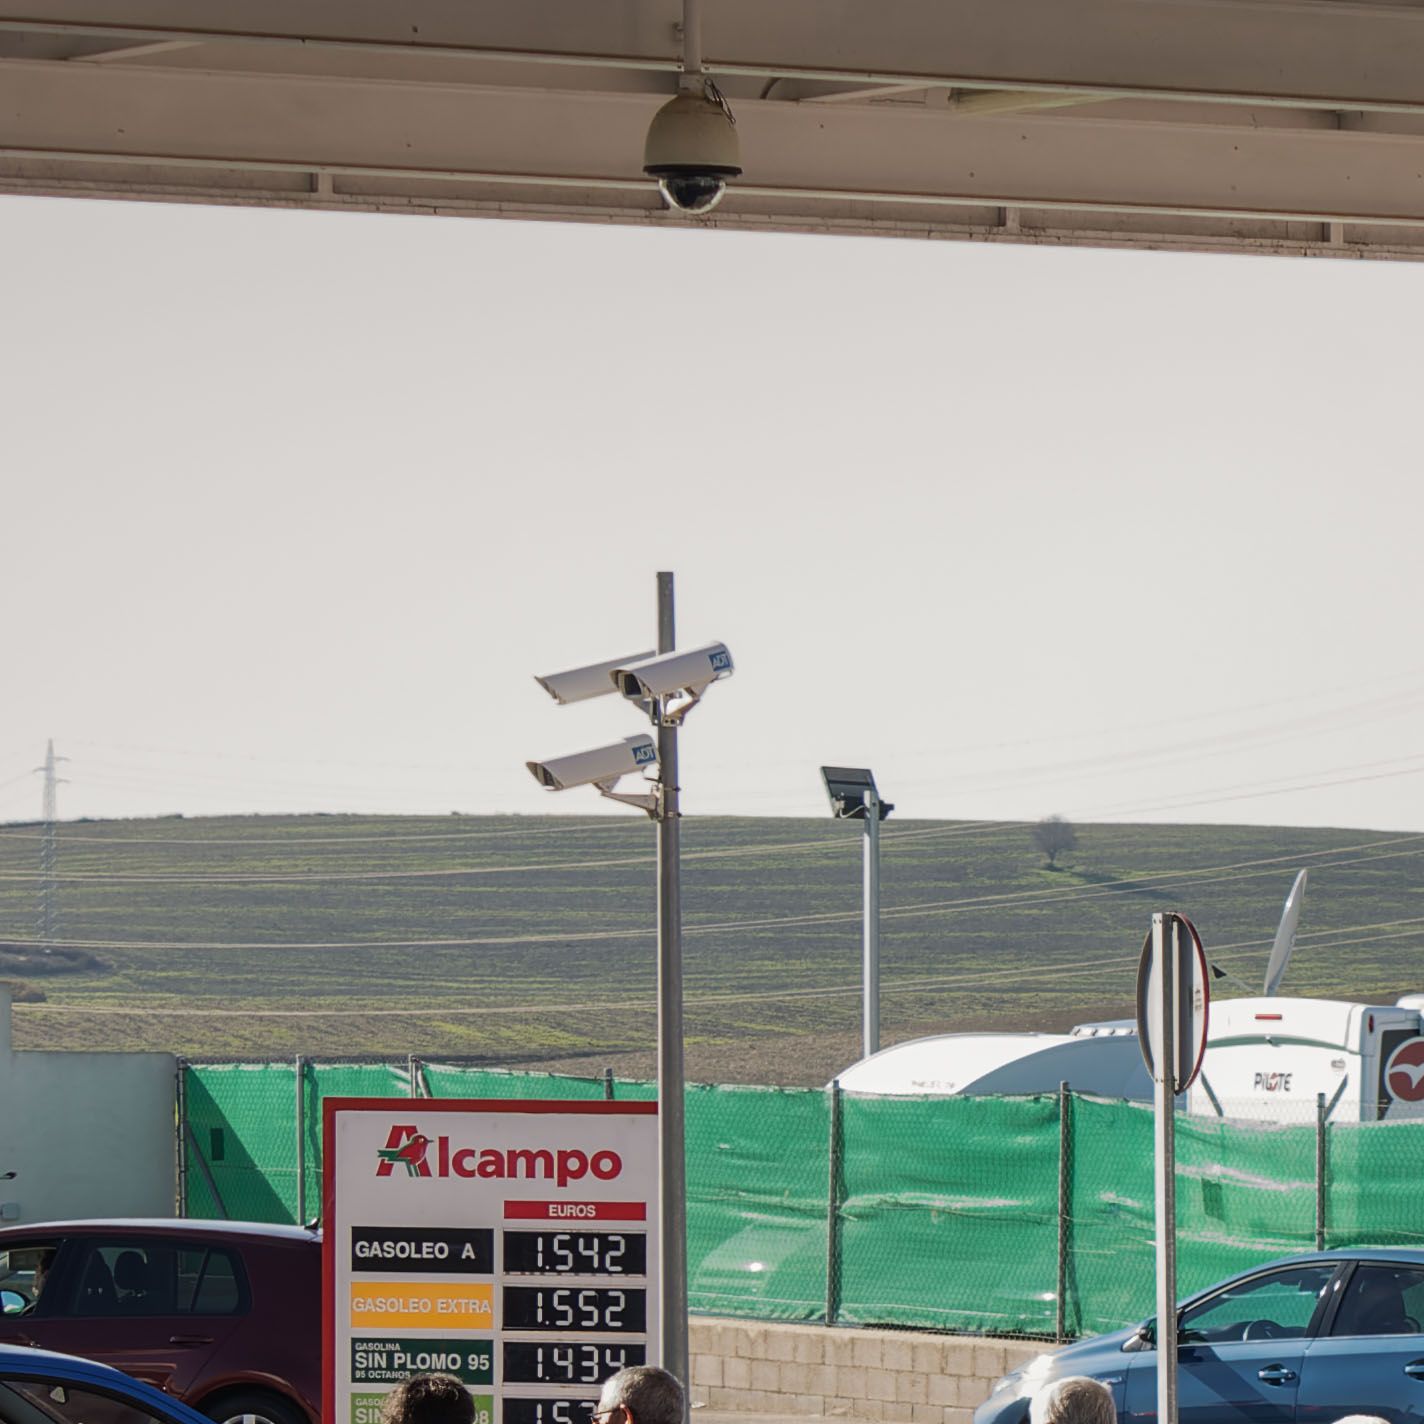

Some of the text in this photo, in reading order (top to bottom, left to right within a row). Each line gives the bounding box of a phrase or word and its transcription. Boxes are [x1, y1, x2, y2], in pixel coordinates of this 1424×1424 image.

[711, 653, 730, 668] ADT
[636, 747, 655, 762] ADT
[376, 1125, 623, 1188] Alcampo
[549, 1205, 596, 1217] EUROS
[355, 1234, 626, 1272] GASOLEO A 1.542
[352, 1289, 626, 1327] GASOLEO EXTRA 1.552
[355, 1341, 401, 1351] GASOLINA
[355, 1345, 626, 1382] SIN PLOMO 95 1.434
[355, 1370, 367, 1379] 95
[355, 1398, 386, 1407] GASO
